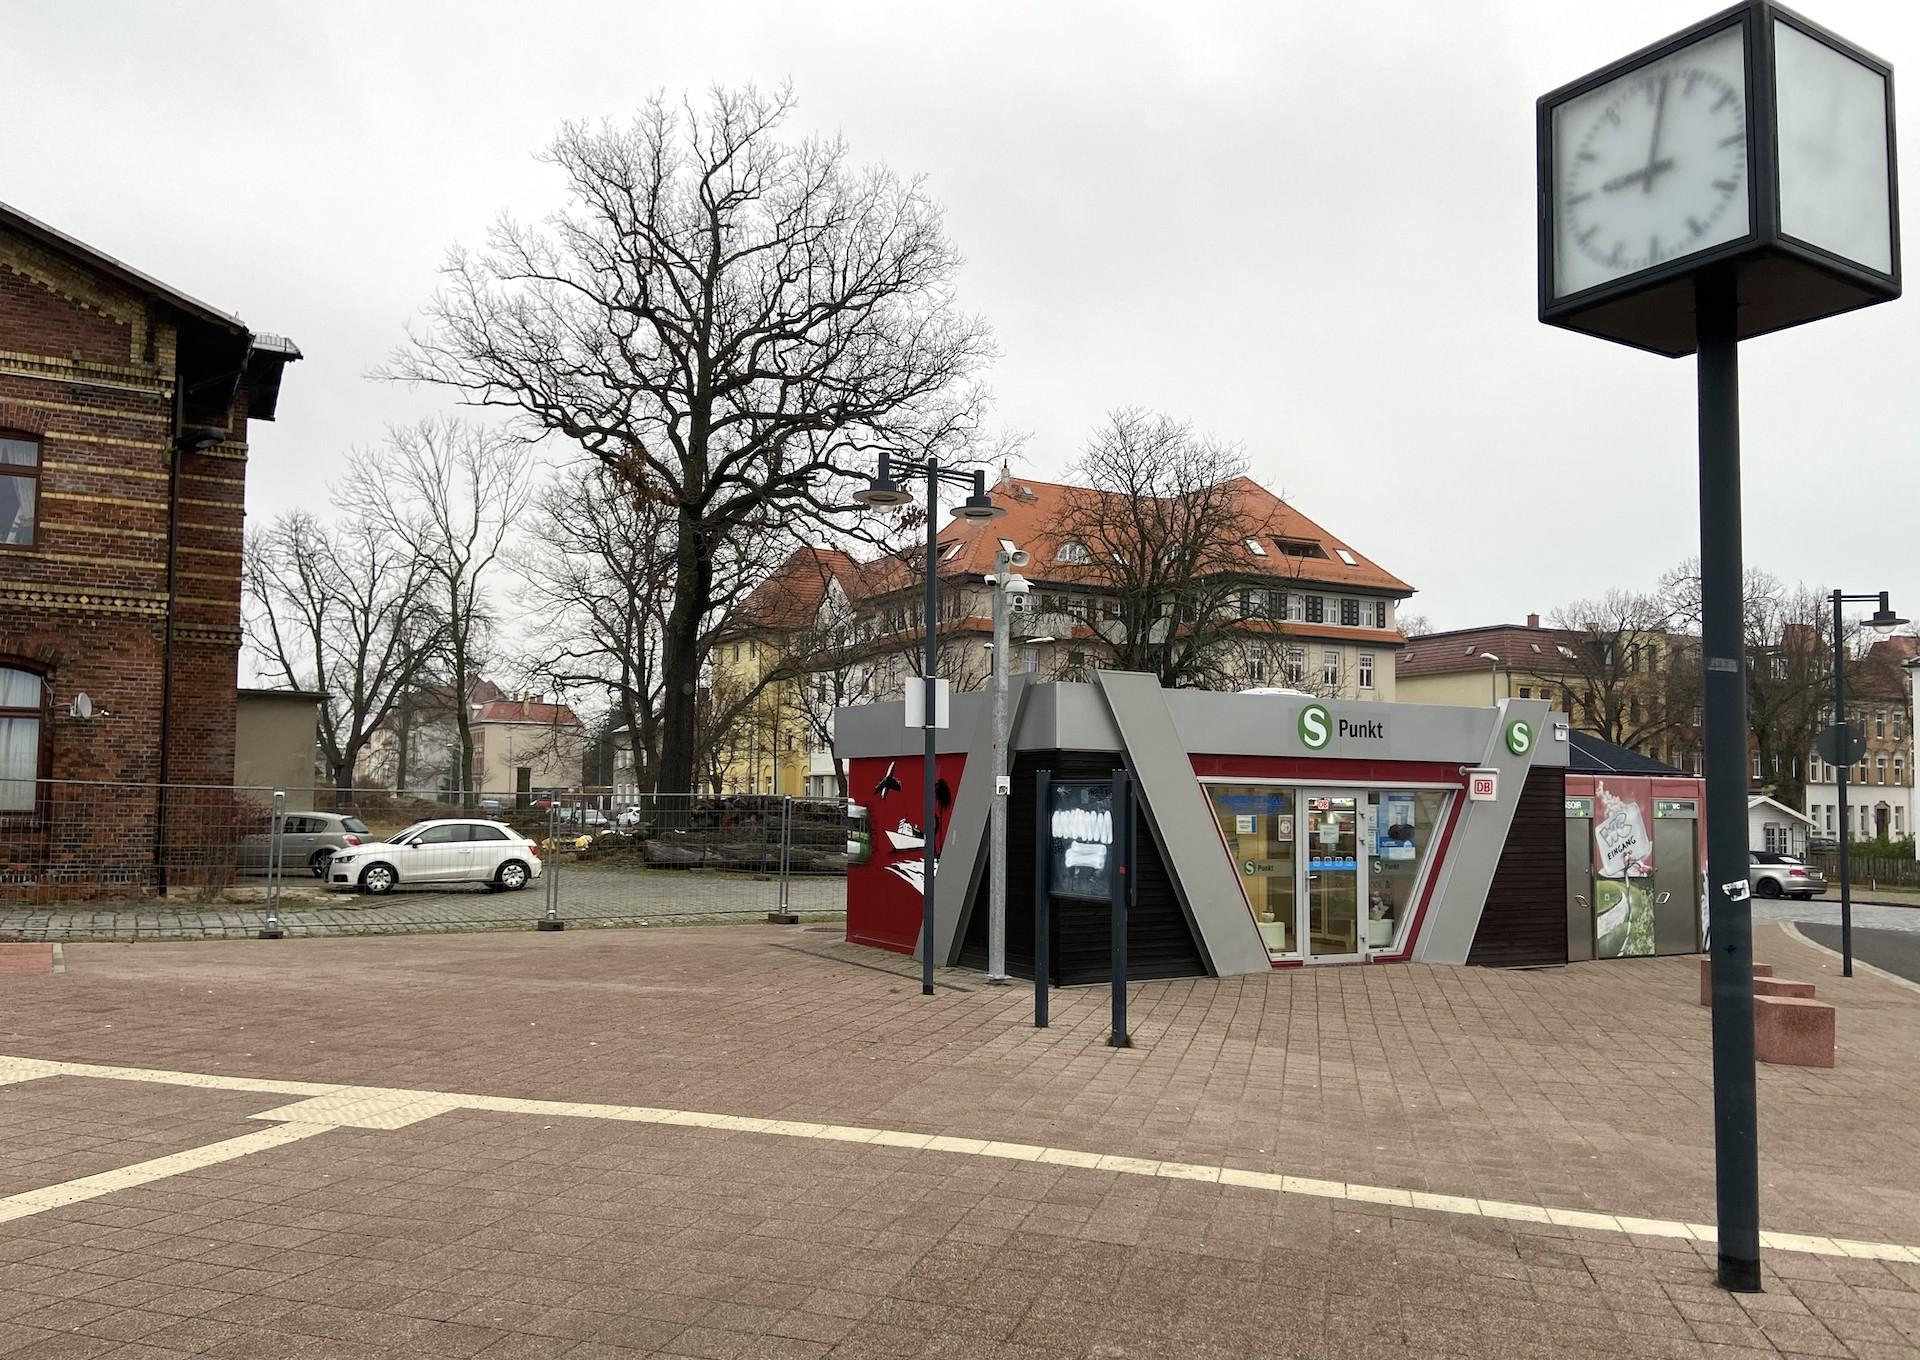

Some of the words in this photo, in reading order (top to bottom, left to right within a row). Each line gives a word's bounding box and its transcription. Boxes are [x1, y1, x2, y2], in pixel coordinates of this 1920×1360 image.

[1304, 708, 1327, 747] S
[1339, 719, 1383, 739] Punkt
[1512, 722, 1529, 753] S
[1476, 781, 1491, 793] DB
[1318, 801, 1328, 809] DB
[1599, 812, 1633, 847] WC
[1607, 835, 1637, 861] EINGANG
[1245, 861, 1255, 875] S
[1257, 864, 1274, 872] Punkt
[1374, 860, 1382, 873] S
